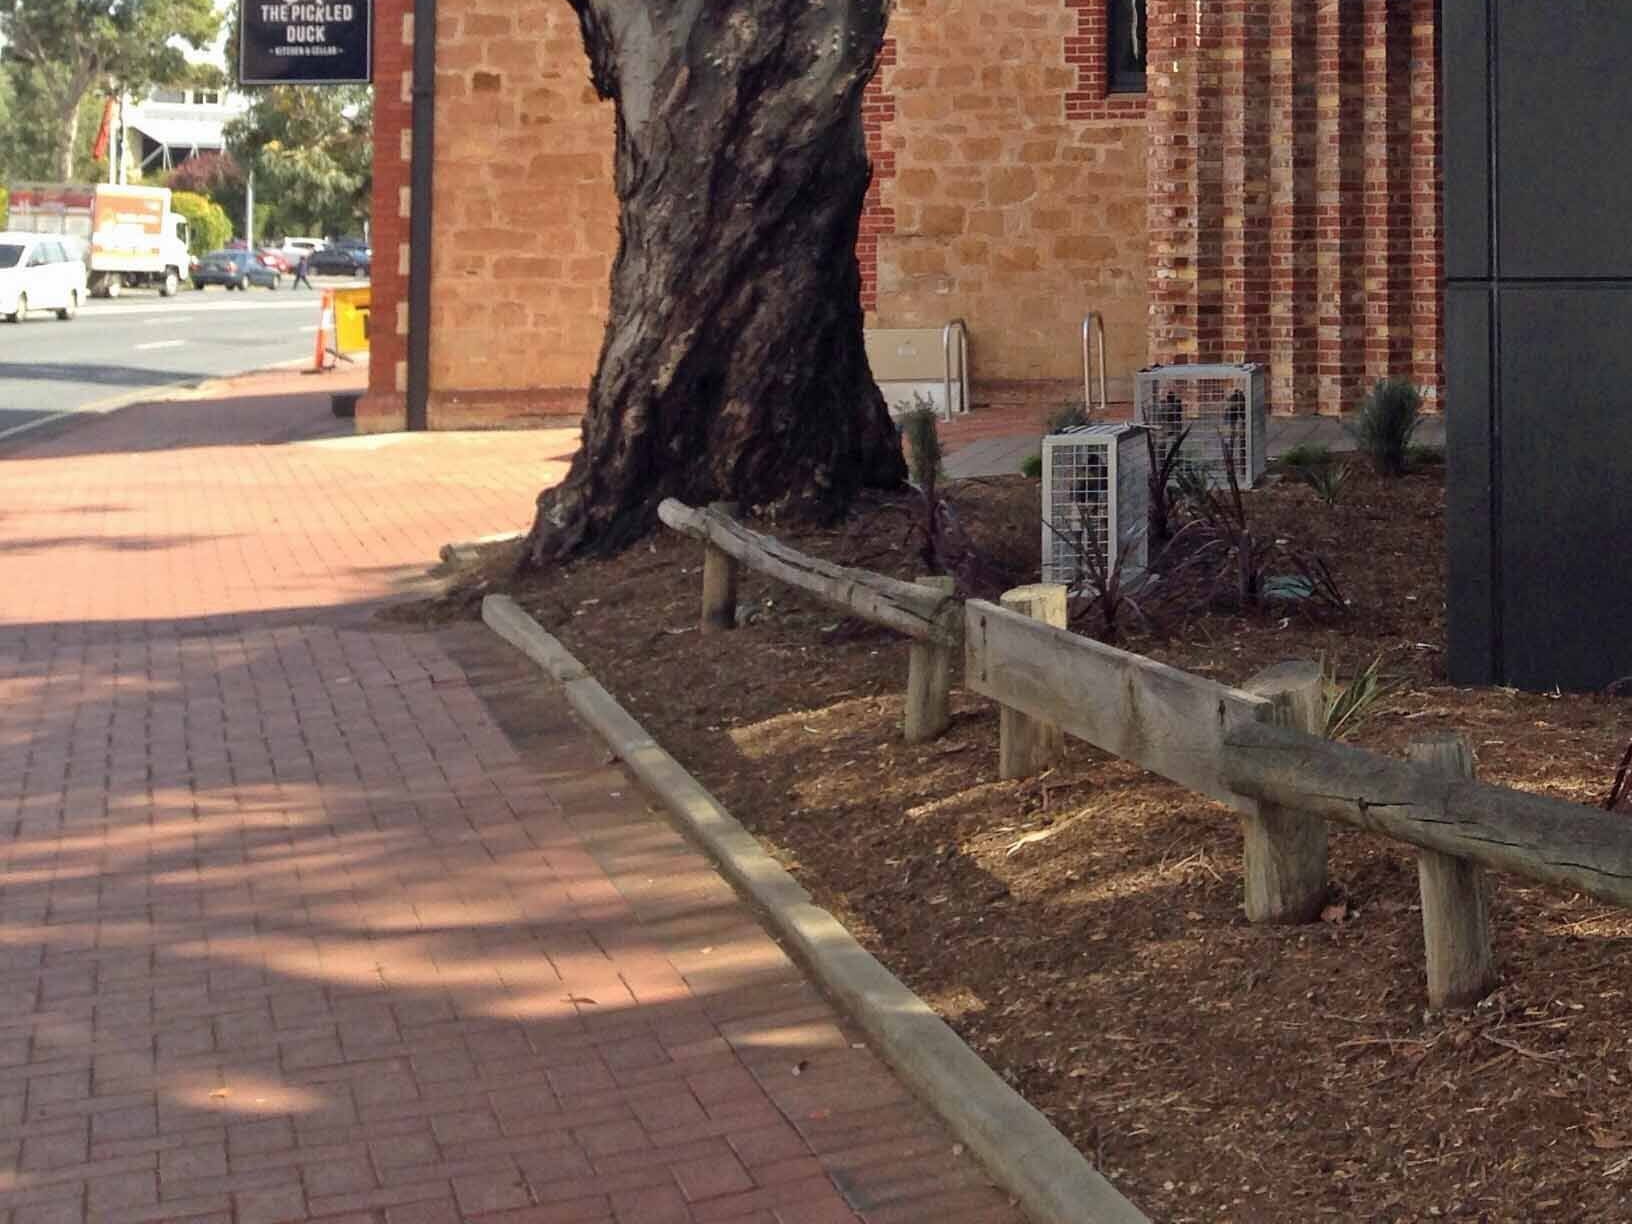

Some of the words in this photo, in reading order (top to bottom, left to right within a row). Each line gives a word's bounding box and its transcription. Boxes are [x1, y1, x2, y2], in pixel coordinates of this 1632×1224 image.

[261, 5, 289, 22] THE
[292, 4, 353, 22] PICKLED
[287, 25, 326, 42] DUCK
